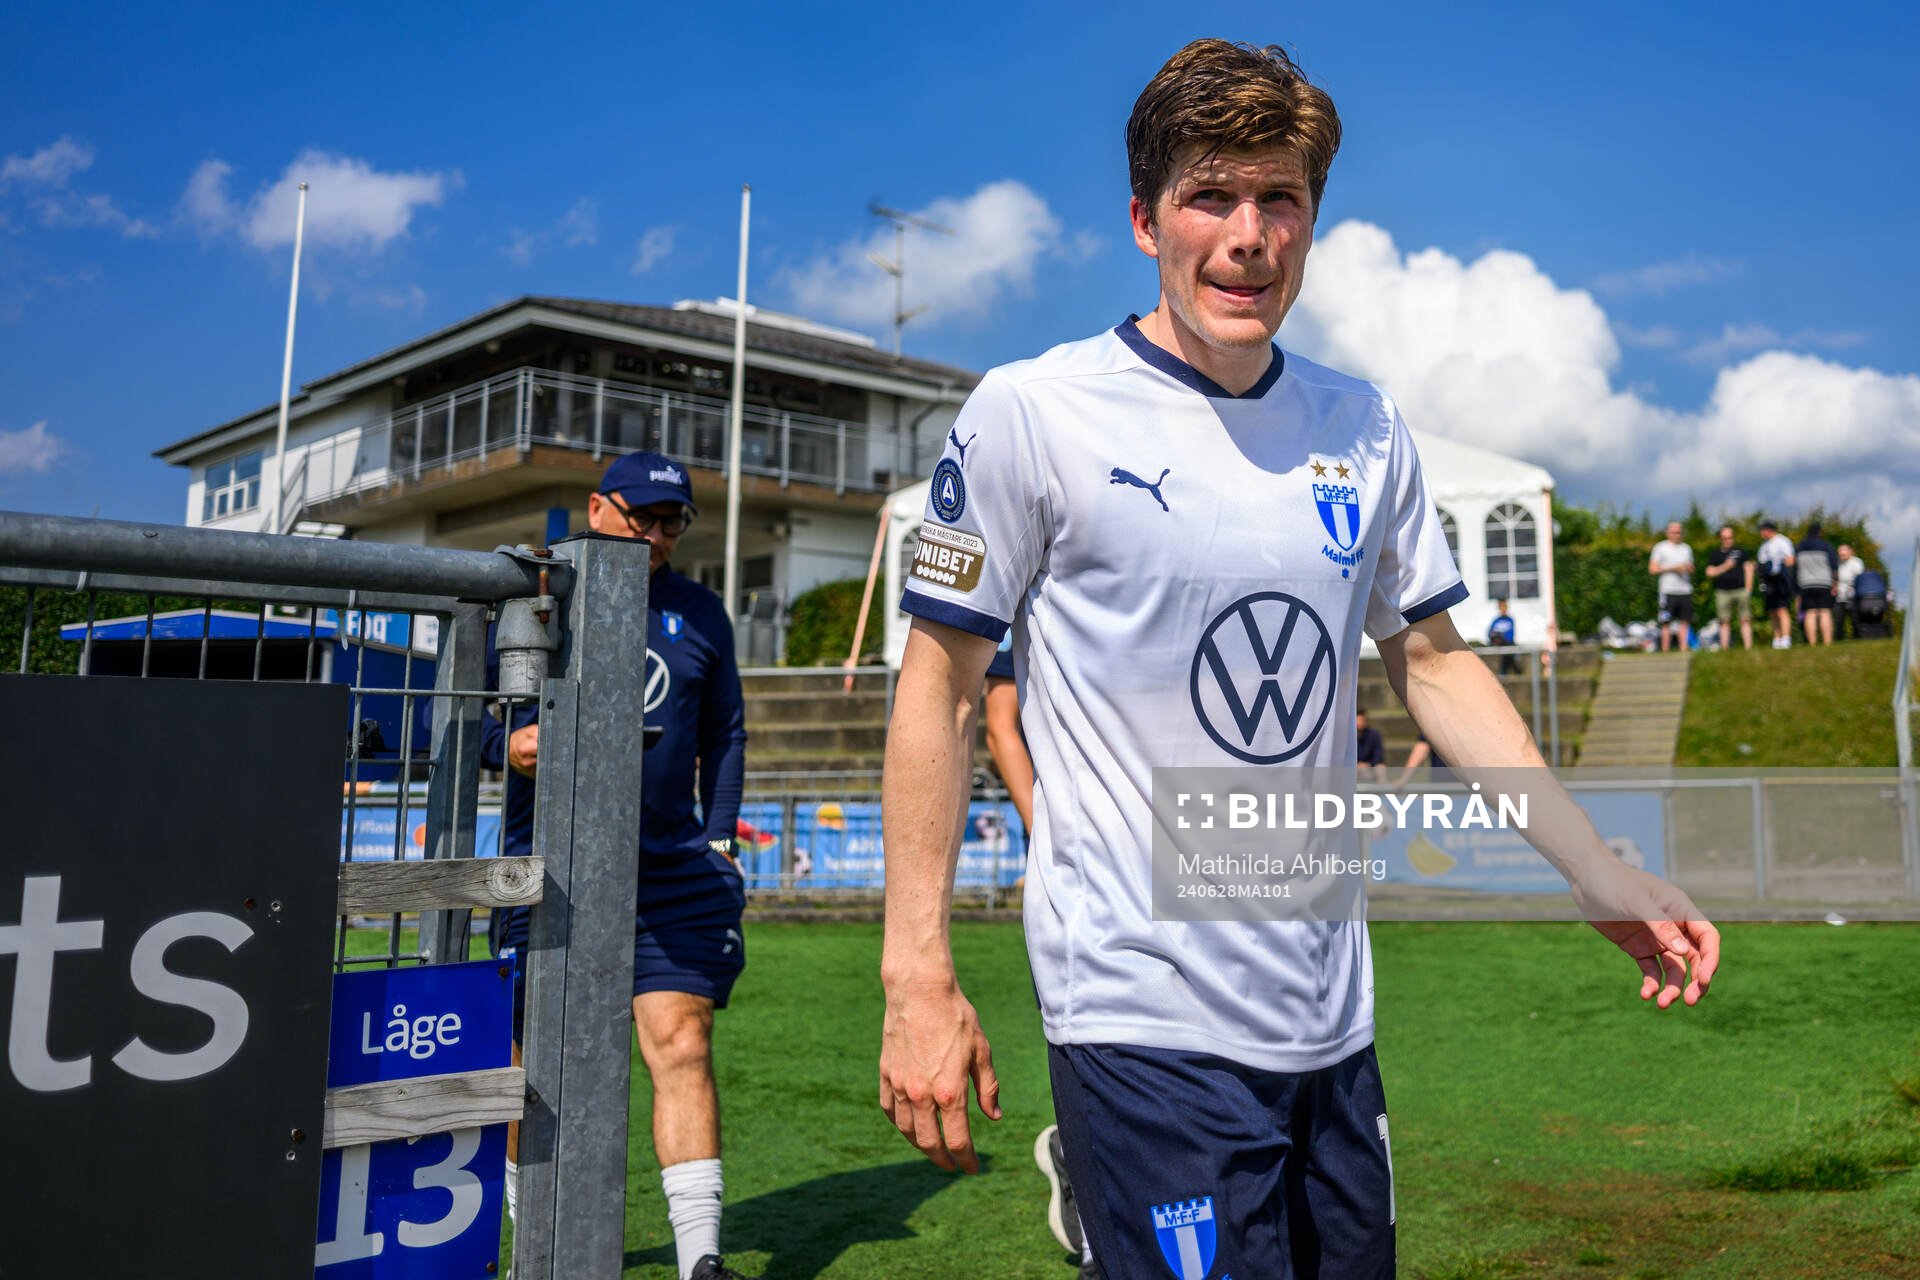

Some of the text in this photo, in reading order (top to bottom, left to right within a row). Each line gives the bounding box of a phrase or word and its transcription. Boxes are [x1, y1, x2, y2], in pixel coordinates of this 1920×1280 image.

[963, 537, 979, 548] 2023
[1321, 544, 1356, 567] Malmö
[914, 540, 975, 575] UNIBET
[361, 1003, 463, 1060] Låge
